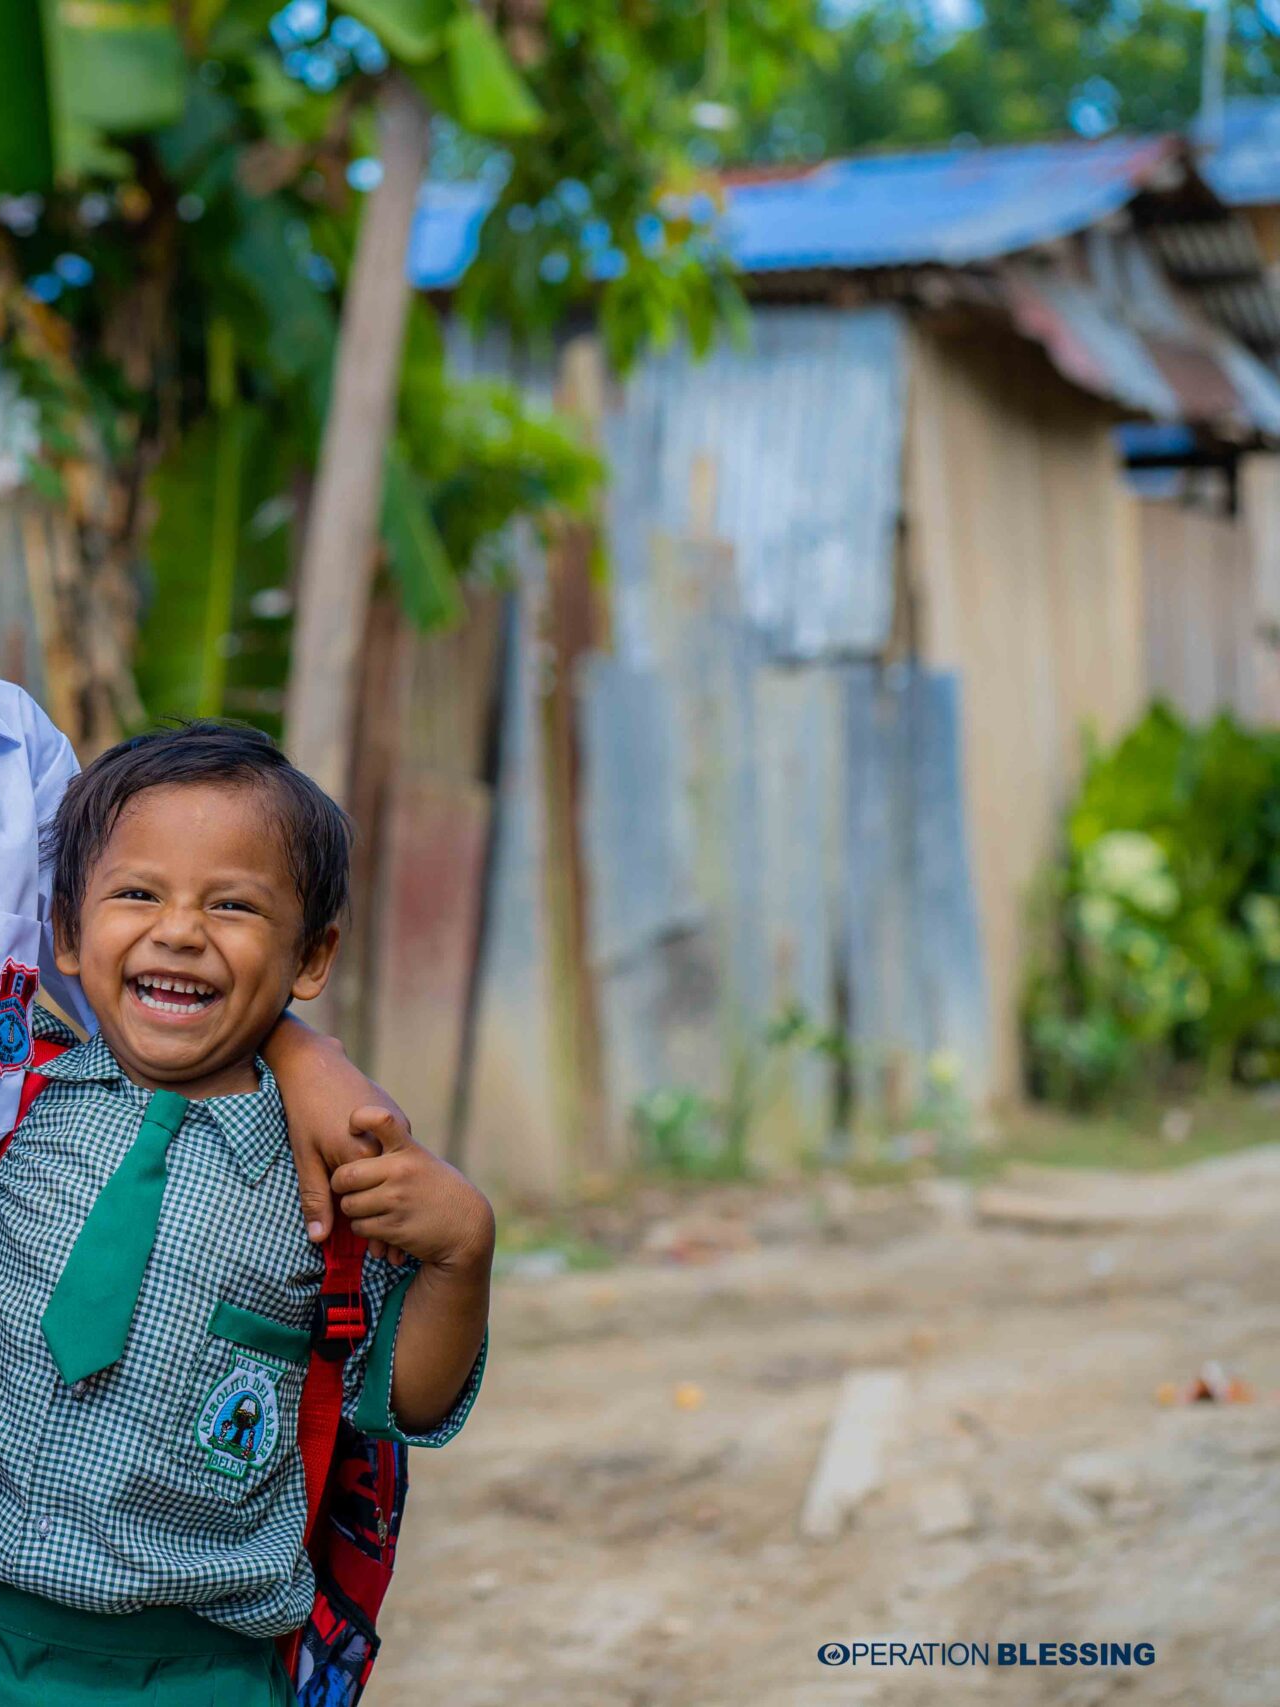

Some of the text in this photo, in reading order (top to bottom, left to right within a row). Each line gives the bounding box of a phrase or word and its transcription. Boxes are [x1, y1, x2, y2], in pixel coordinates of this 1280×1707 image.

[200, 1375, 275, 1459] ARBOLITO DEL SABER
[211, 1453, 247, 1475] BELEN
